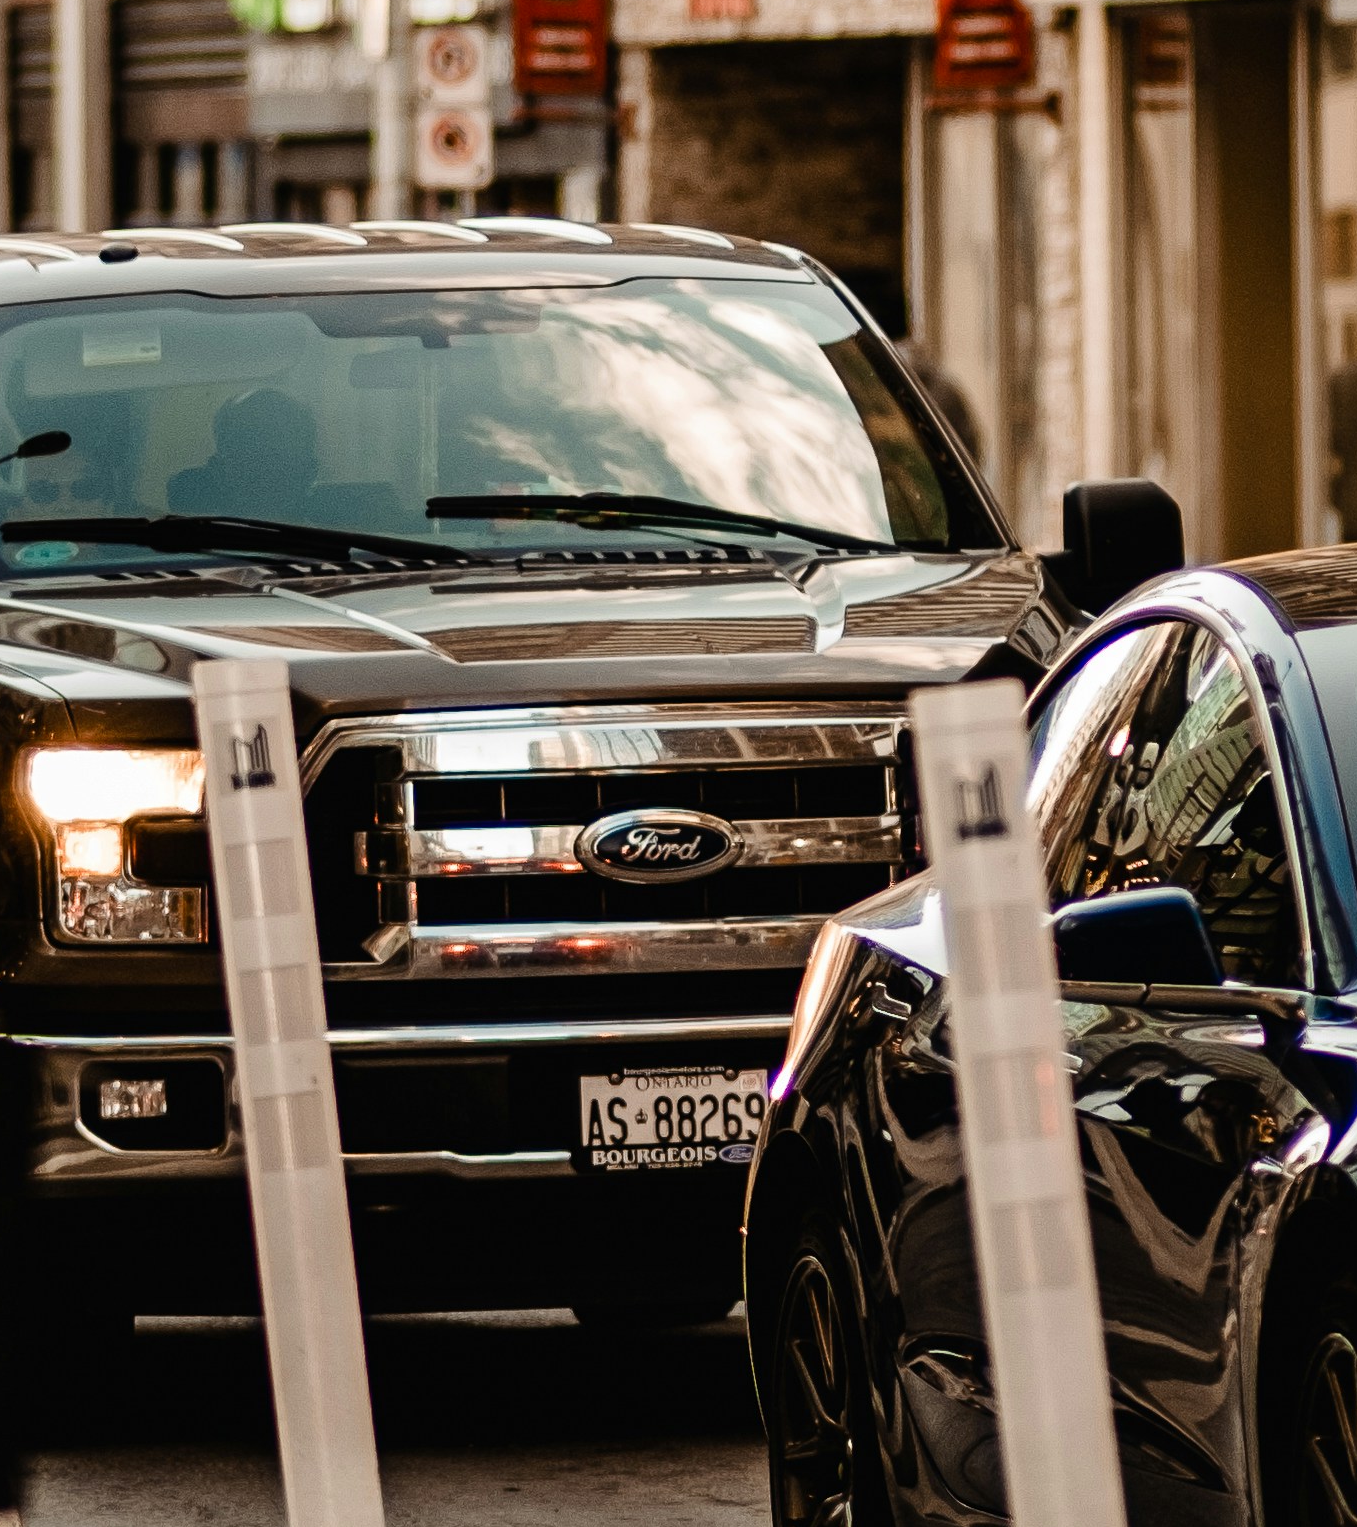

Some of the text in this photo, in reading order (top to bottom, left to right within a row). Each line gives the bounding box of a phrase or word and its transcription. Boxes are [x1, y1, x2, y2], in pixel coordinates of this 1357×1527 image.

[621, 827, 702, 862] Ford
[588, 1092, 764, 1146] AS 88269
[593, 1146, 717, 1165] BOURGEOIS
